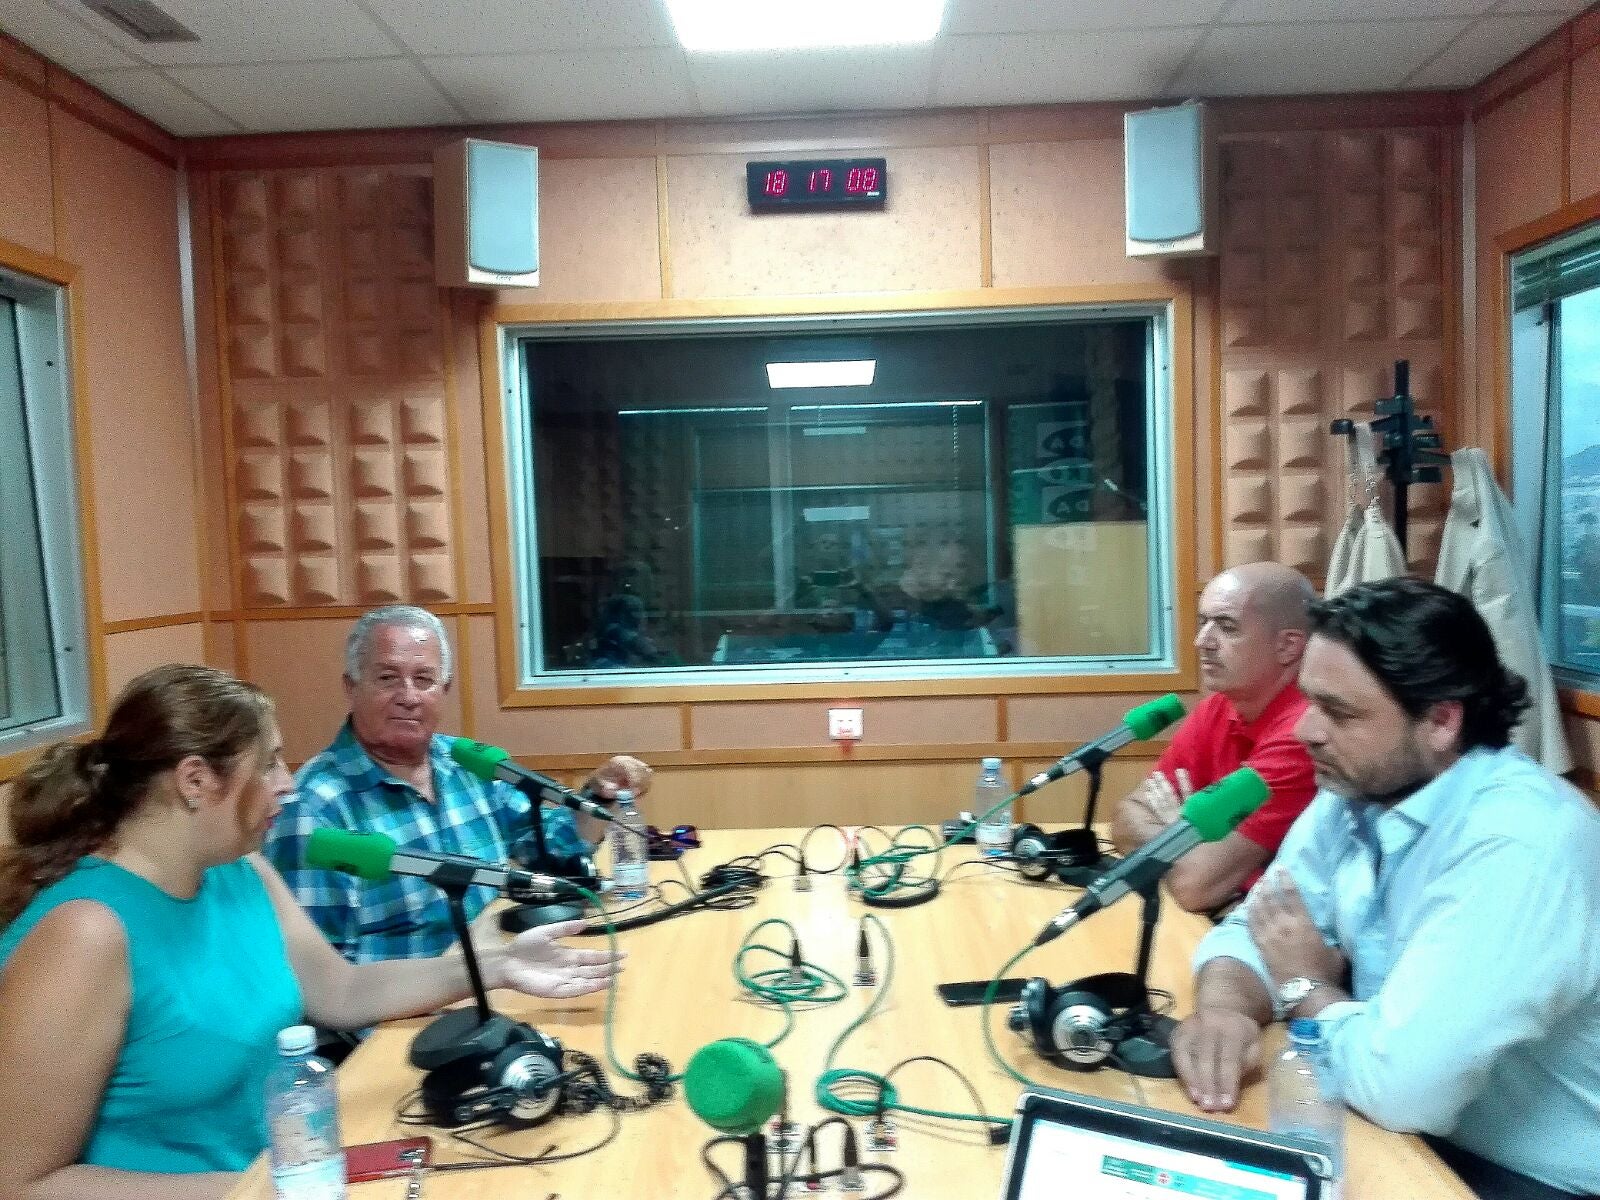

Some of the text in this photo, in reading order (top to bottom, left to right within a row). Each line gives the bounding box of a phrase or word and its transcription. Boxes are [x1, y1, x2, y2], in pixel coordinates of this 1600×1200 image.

[765, 168, 878, 193] 18 17 08
